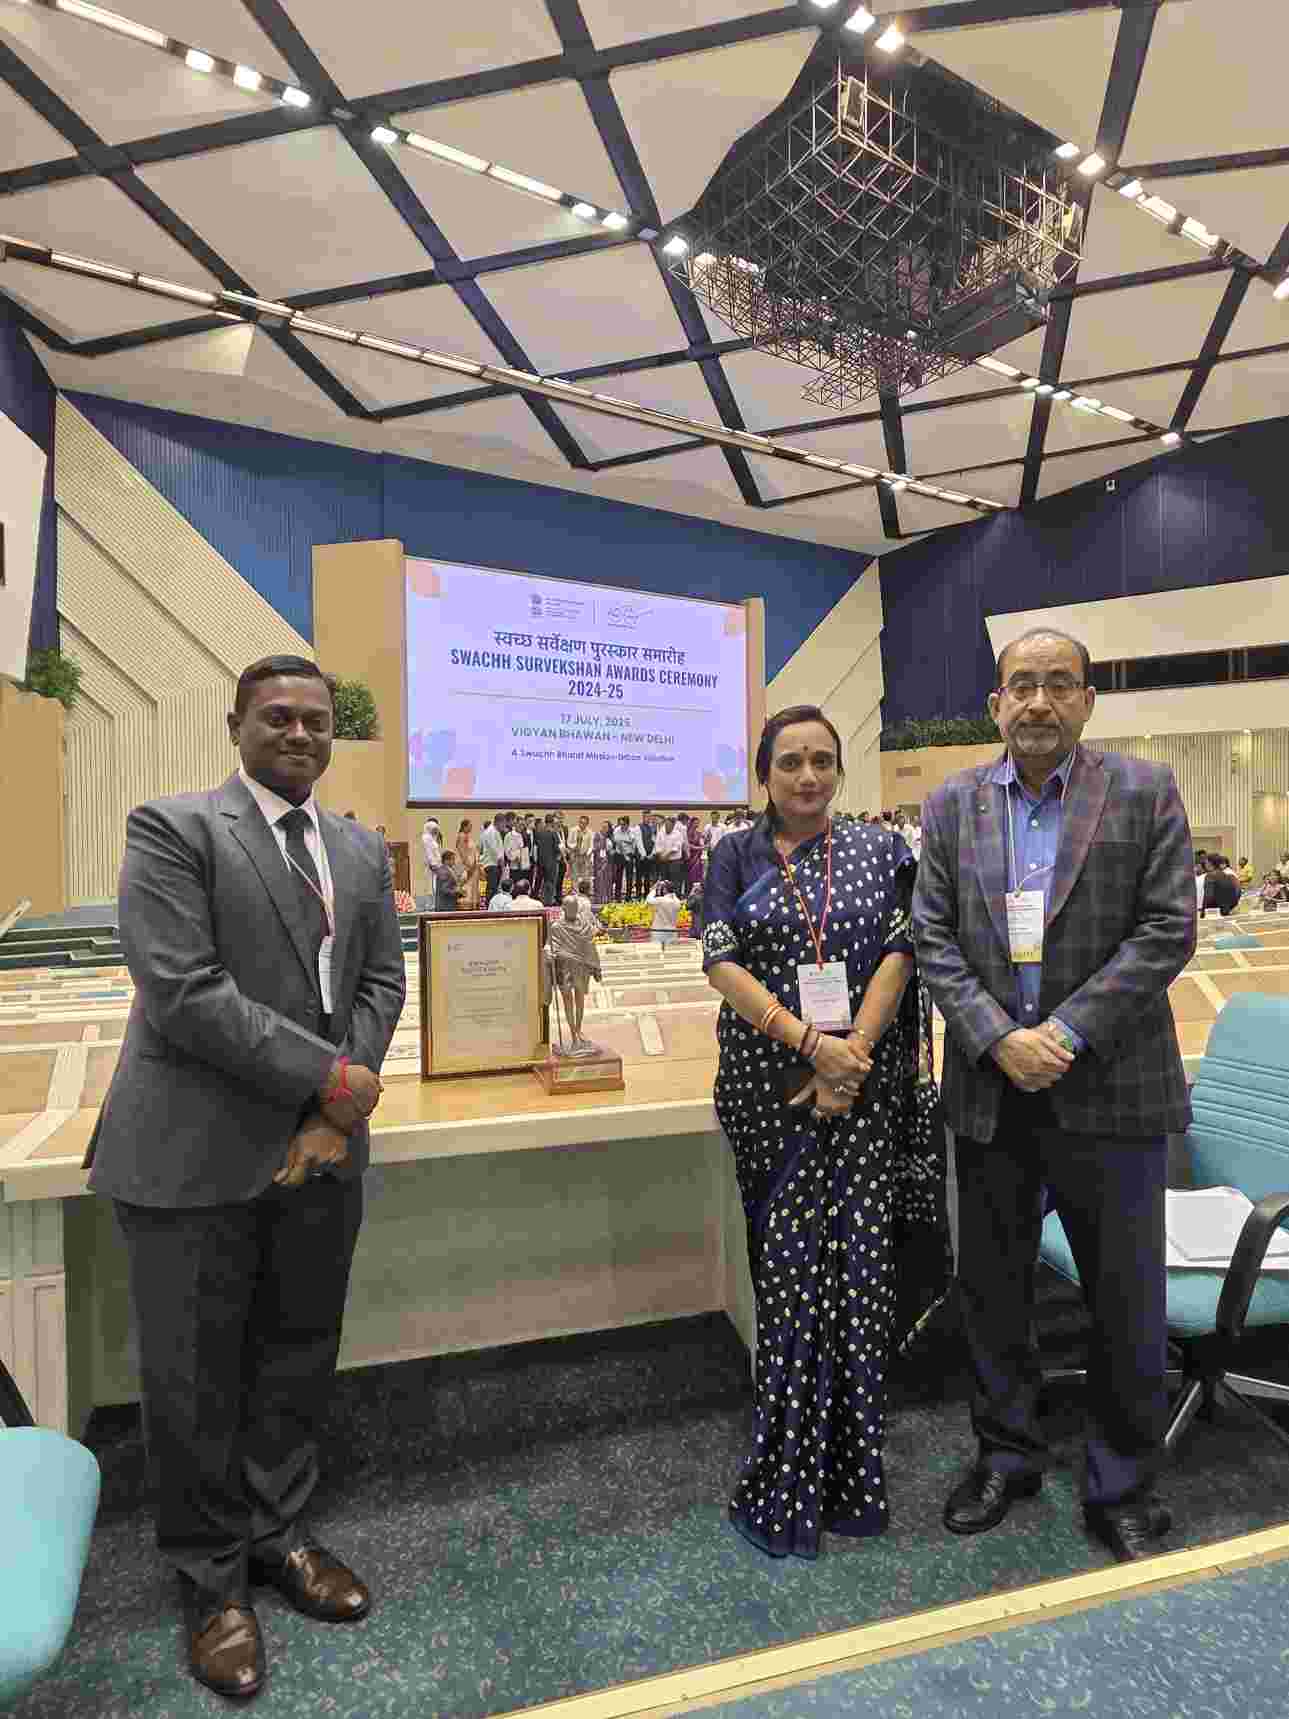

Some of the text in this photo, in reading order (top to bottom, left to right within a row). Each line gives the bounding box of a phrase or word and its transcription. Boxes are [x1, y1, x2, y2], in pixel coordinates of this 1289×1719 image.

[493, 631, 533, 648] स्वच्छ
[590, 641, 640, 661] पुरस्कार
[641, 645, 686, 665] समारोह
[451, 648, 719, 688] SWACHH SURVEKSHAN AWARDS CEREMONY
[568, 679, 624, 699] 2024-25
[621, 732, 644, 744] NEW
[647, 734, 674, 745] DELHI
